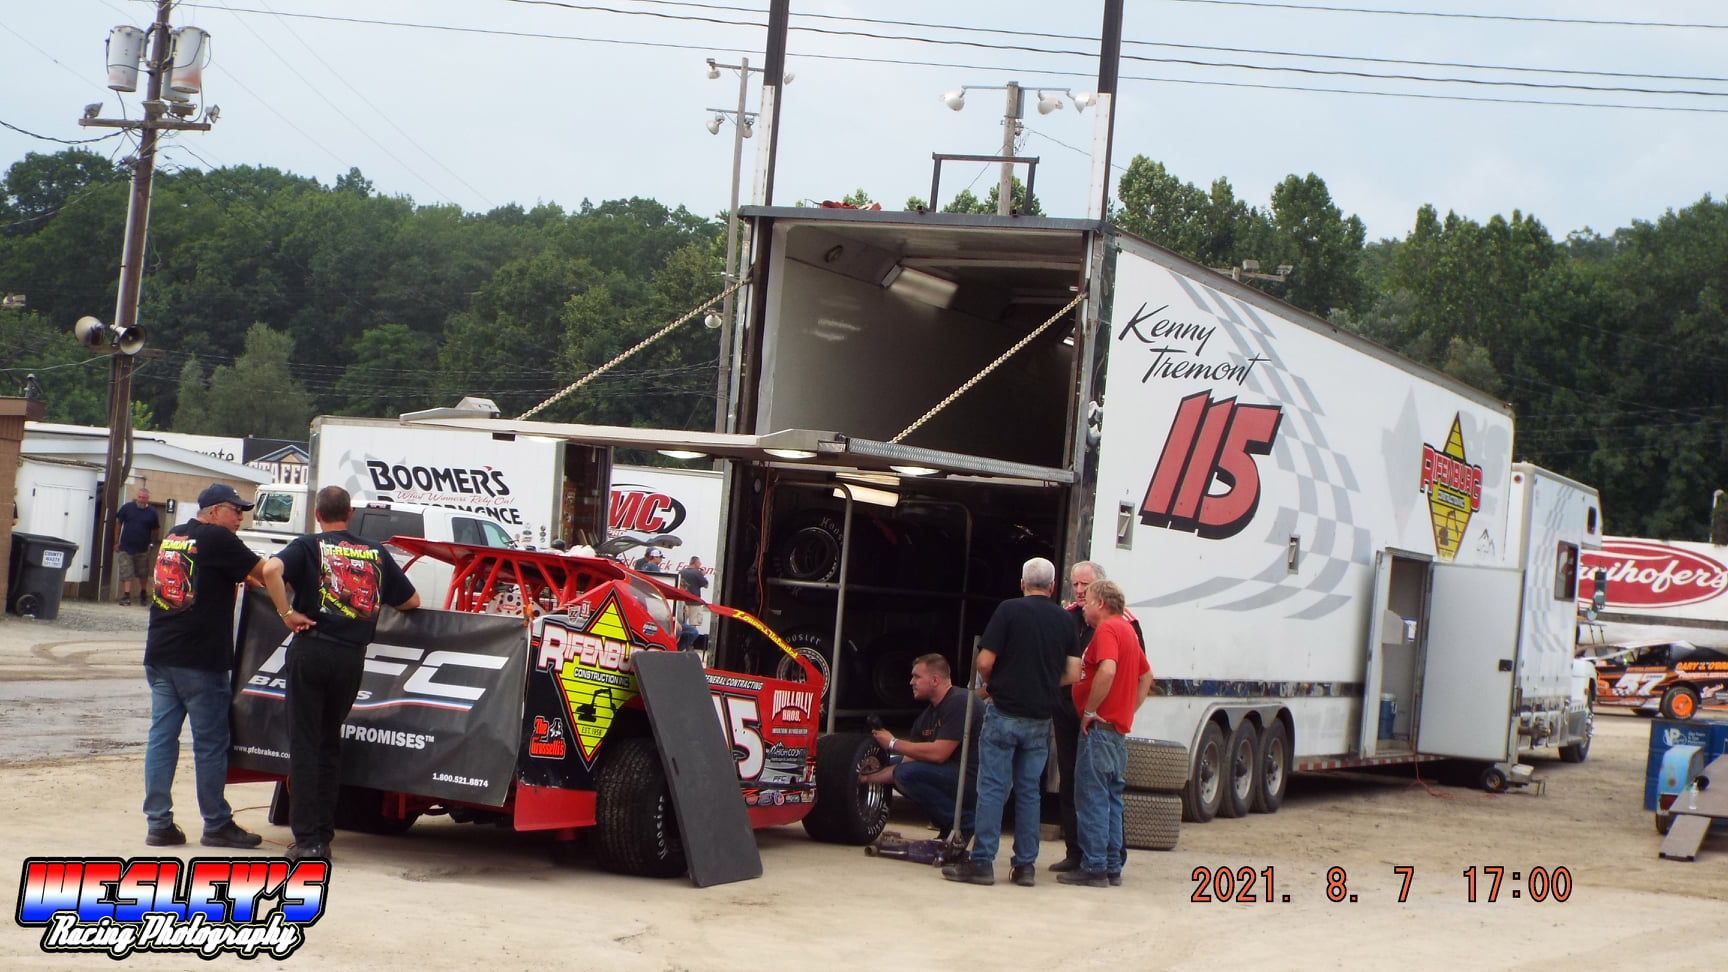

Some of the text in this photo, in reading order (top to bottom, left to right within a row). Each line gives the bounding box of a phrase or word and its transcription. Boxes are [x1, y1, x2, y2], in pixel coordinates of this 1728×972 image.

[1118, 302, 1216, 356] Kenny
[1142, 346, 1272, 386] Tremont
[367, 460, 510, 499] BOOMER'S
[1139, 389, 1284, 540] 115
[1420, 443, 1482, 513] RIFENBURG
[428, 492, 466, 502] Winners
[470, 494, 491, 506] Rely
[538, 624, 652, 672] RIFENBU
[574, 667, 619, 685] CONSTRUCTION
[704, 674, 764, 691] ENERAL CONTRACTING
[772, 689, 814, 721] MULLALLY
[432, 773, 489, 788] 1.800.521.8874
